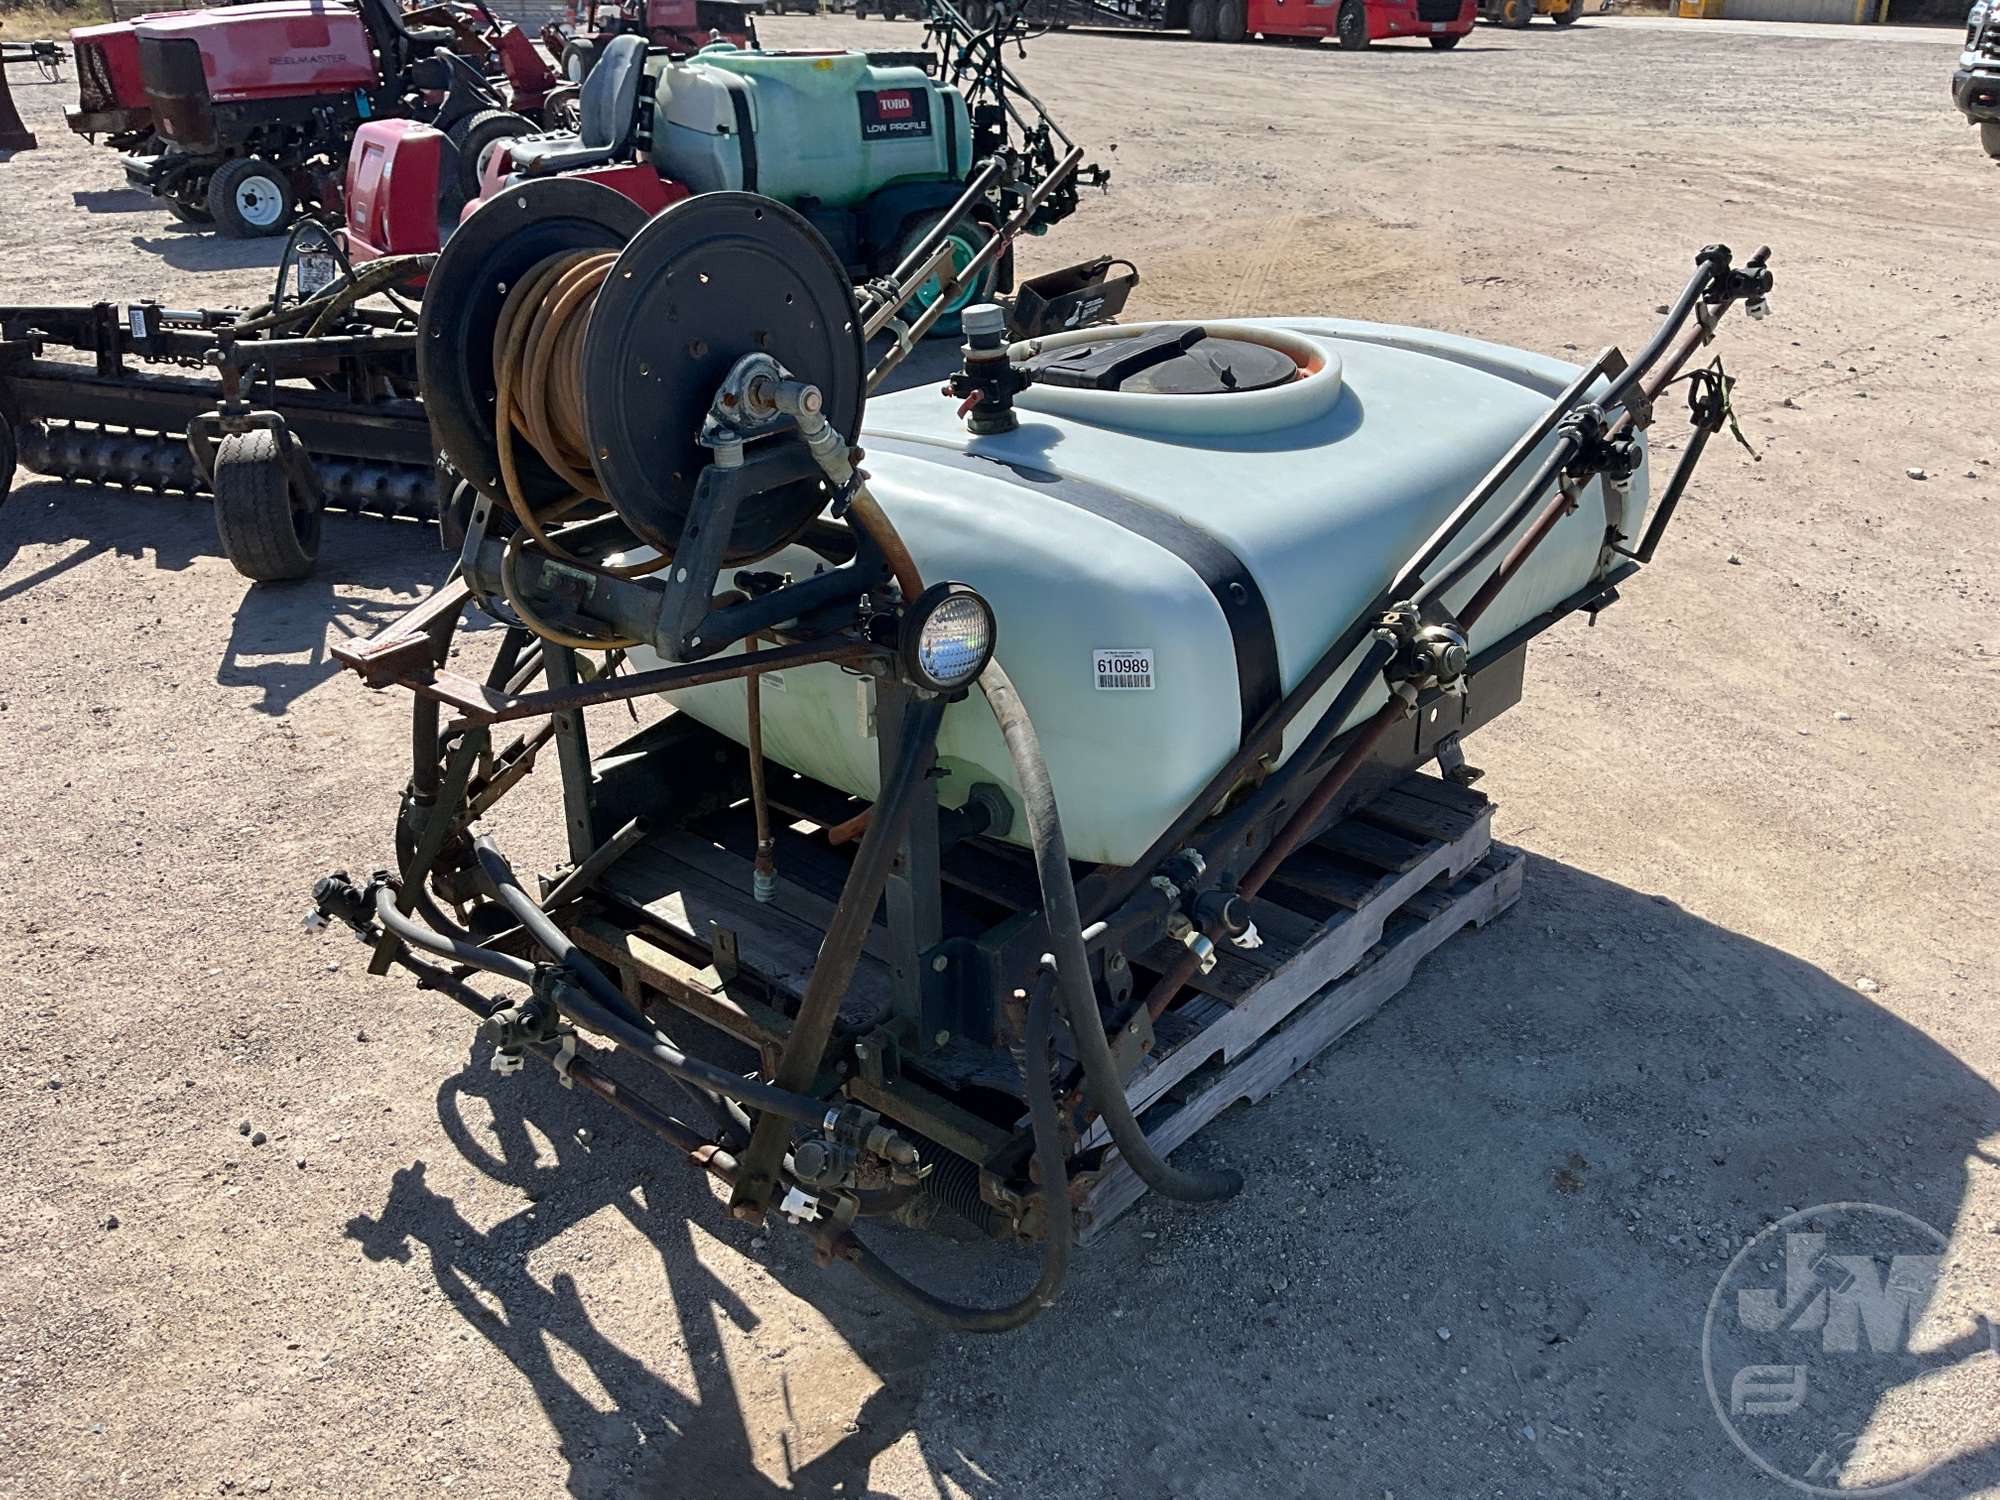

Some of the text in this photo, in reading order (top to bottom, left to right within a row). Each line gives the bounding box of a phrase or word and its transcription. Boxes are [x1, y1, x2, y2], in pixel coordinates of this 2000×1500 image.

[880, 98, 910, 110] TORO
[866, 121, 927, 133] LOW PROFILE
[1098, 659, 1149, 673] 610989
